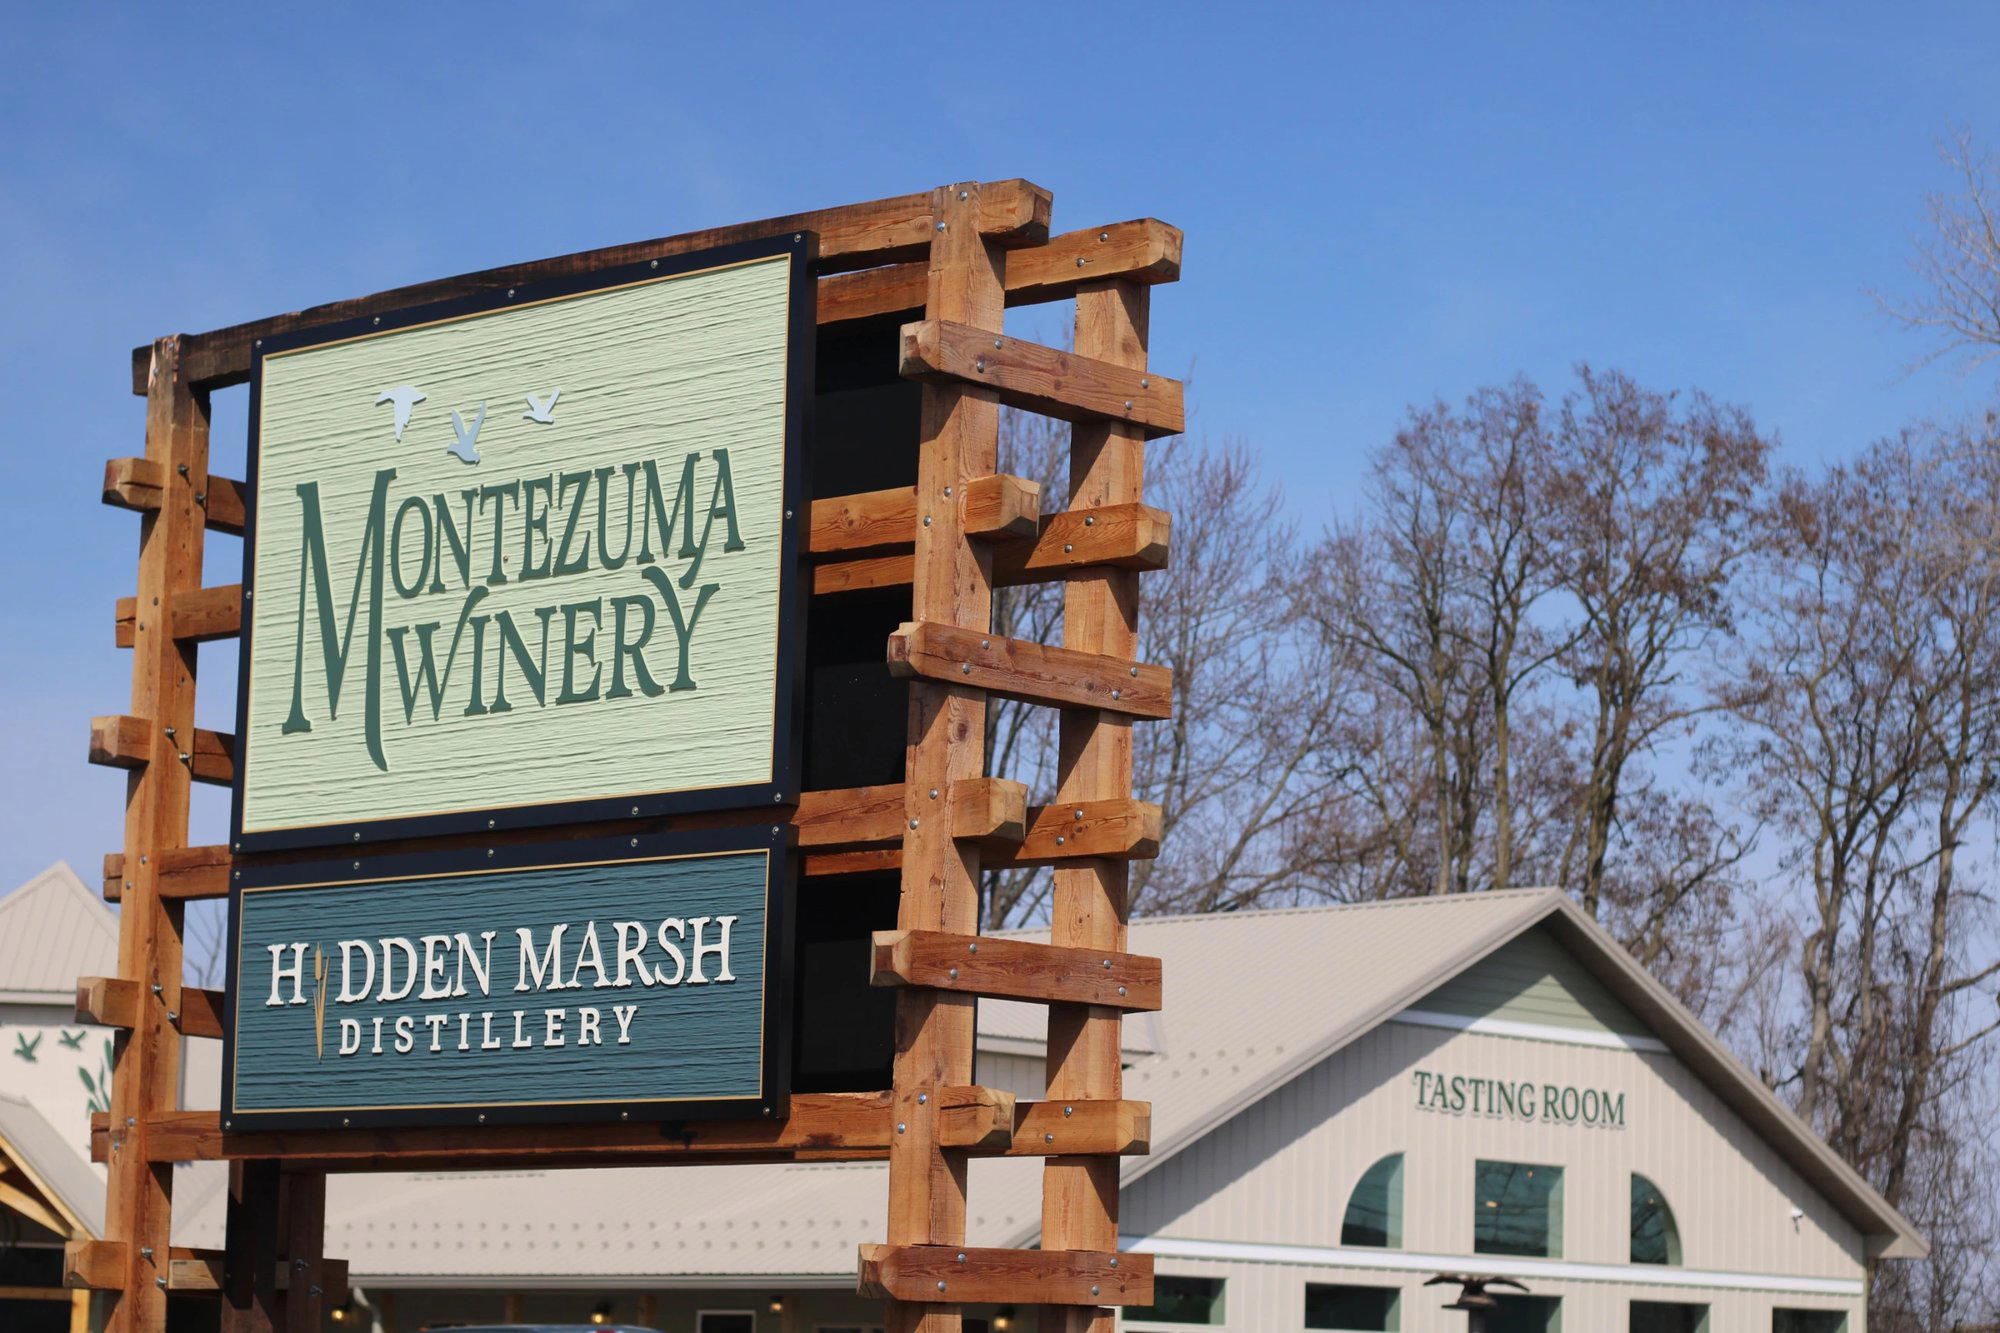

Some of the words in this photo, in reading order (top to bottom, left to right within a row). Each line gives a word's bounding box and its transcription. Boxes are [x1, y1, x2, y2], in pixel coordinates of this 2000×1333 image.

[282, 448, 746, 771] MONTEZUMA
[386, 566, 721, 725] WINERY
[514, 915, 739, 992] MARSH
[338, 1005, 638, 1056] DISTILLERY
[1414, 1071, 1536, 1118] TASTING
[1542, 1085, 1625, 1125] ROOM
